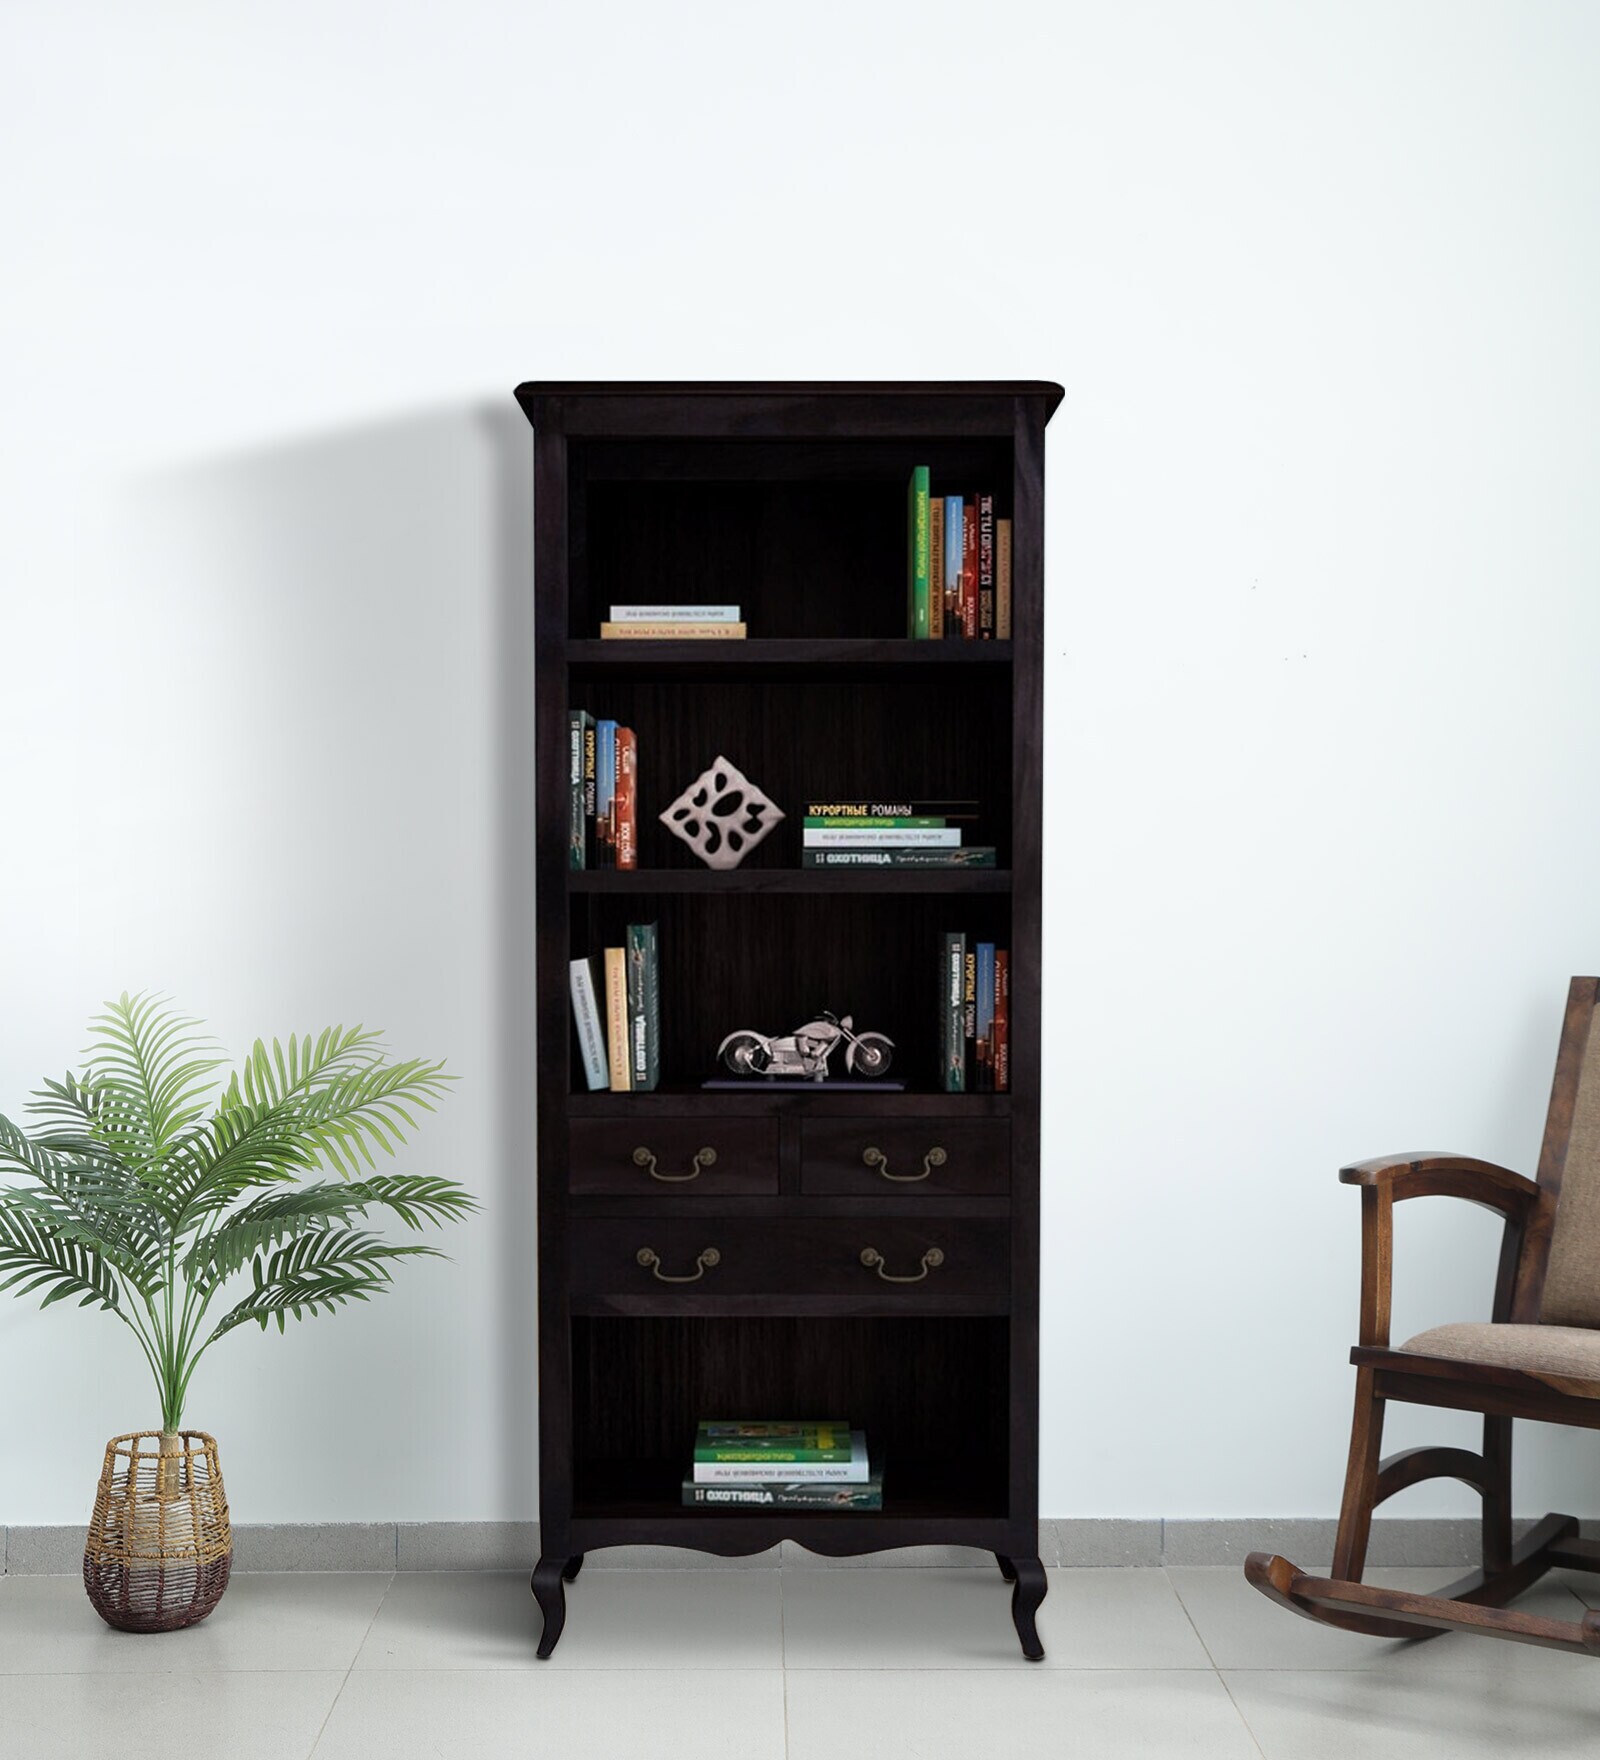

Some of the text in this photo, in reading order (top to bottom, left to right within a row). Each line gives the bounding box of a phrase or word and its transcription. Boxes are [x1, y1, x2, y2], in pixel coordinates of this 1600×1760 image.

[808, 804, 912, 816] КУРОРТНЫЕ РОМАНЫ
[826, 853, 892, 865] ОХОТНИЦА
[706, 1490, 774, 1504] ОХОТНИЦА
